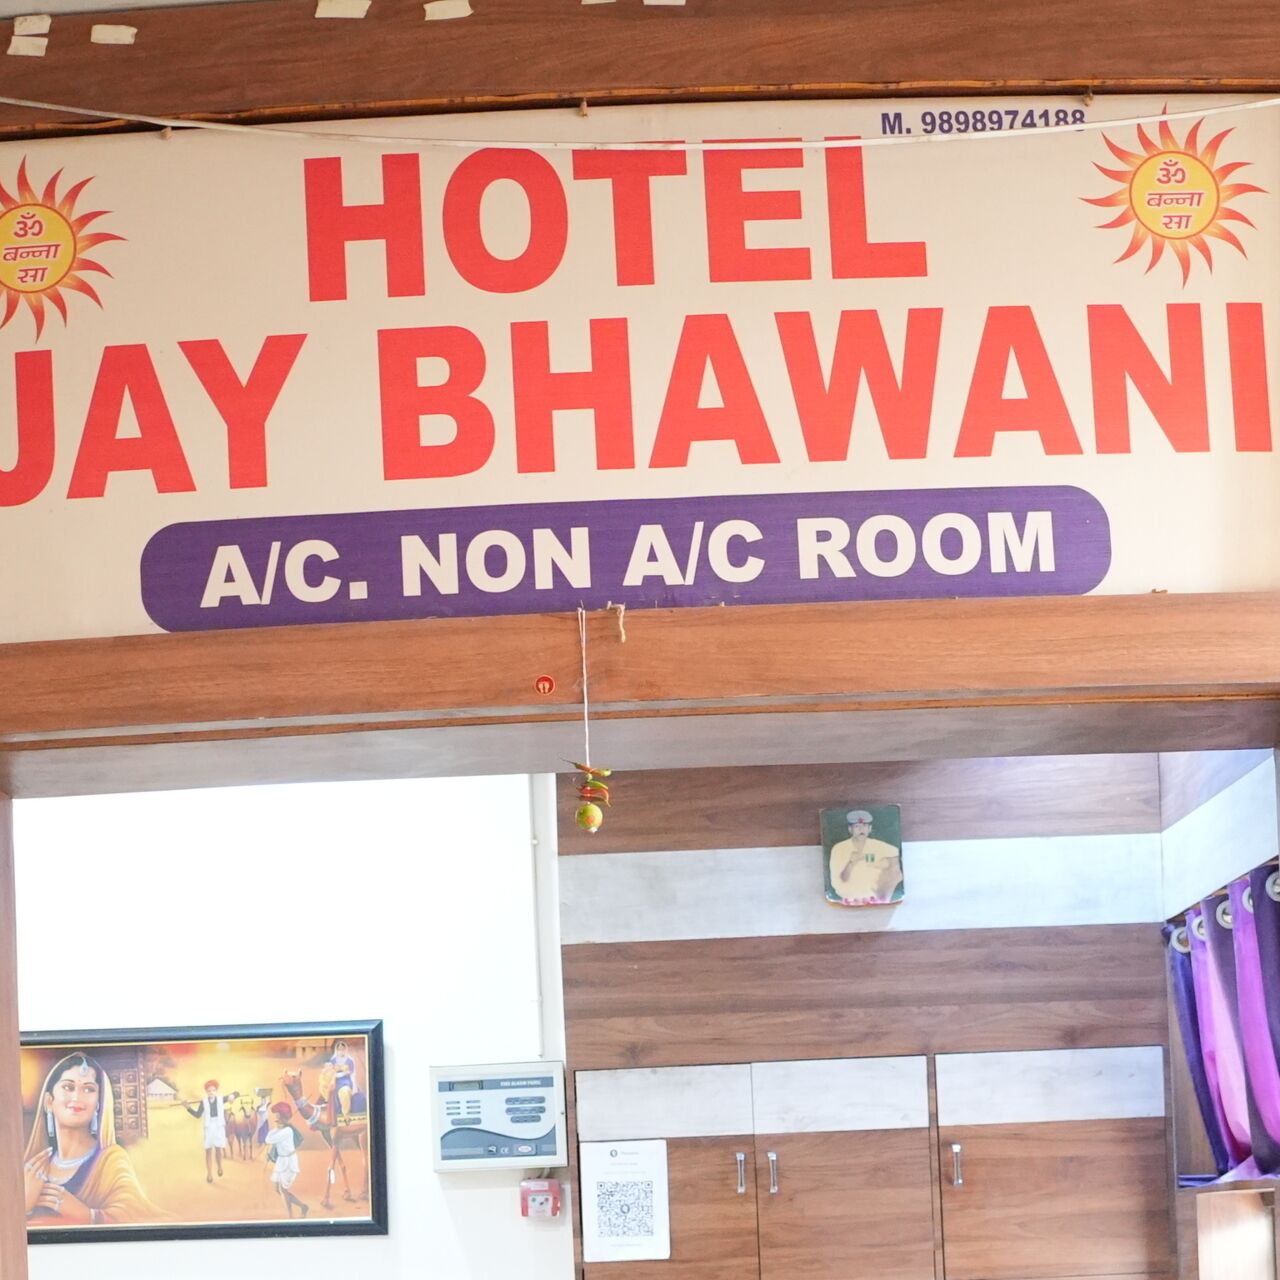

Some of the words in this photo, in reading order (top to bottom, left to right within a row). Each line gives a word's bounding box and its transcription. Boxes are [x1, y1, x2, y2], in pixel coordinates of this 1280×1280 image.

[880, 111, 912, 135] M.
[920, 108, 1086, 135] 9898974188
[1146, 191, 1205, 208] बन्ना
[303, 136, 928, 303] HOTEL
[1161, 214, 1193, 230] सा
[2, 243, 62, 262] बन्ना
[17, 267, 49, 284] सा
[376, 302, 1273, 482] BHAWANI
[198, 540, 368, 609] A/C.
[400, 527, 592, 597] NON
[622, 518, 766, 587] A/C
[796, 510, 1057, 582] ROOM
